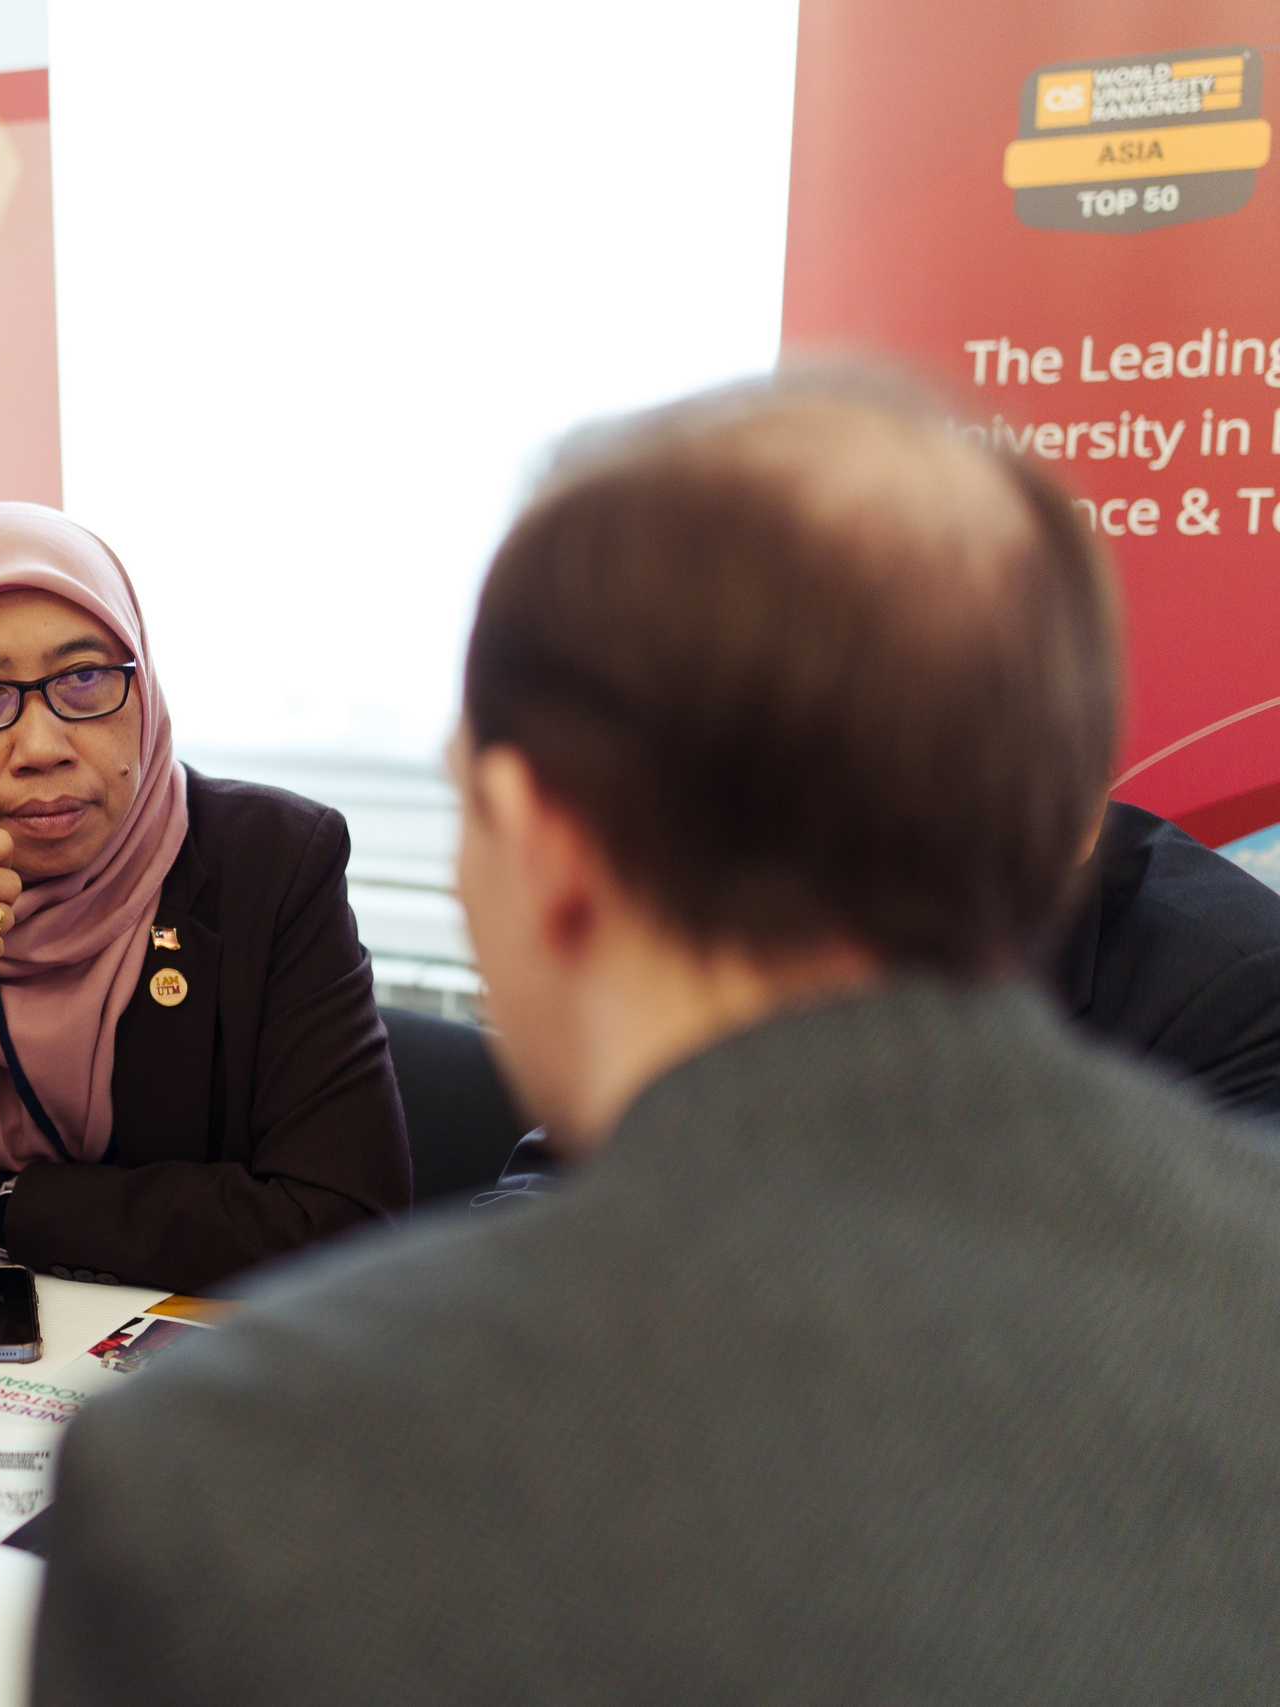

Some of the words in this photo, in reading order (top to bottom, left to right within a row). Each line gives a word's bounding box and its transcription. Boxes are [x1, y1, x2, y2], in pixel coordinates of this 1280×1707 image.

[1093, 62, 1172, 88] WORLD
[1093, 74, 1216, 105] UNIVERSITY
[1043, 84, 1086, 112] QS
[1091, 93, 1203, 123] RANKINGS
[1097, 139, 1165, 166] ASIA
[1077, 188, 1138, 218] TOP
[1142, 184, 1180, 213] 50
[963, 336, 1064, 387] The
[946, 409, 1187, 471] niversity
[1199, 407, 1251, 456] in
[1071, 497, 1161, 536] nce
[1175, 486, 1221, 536] &
[156, 985, 181, 996] UTM
[161, 975, 180, 986] AM
